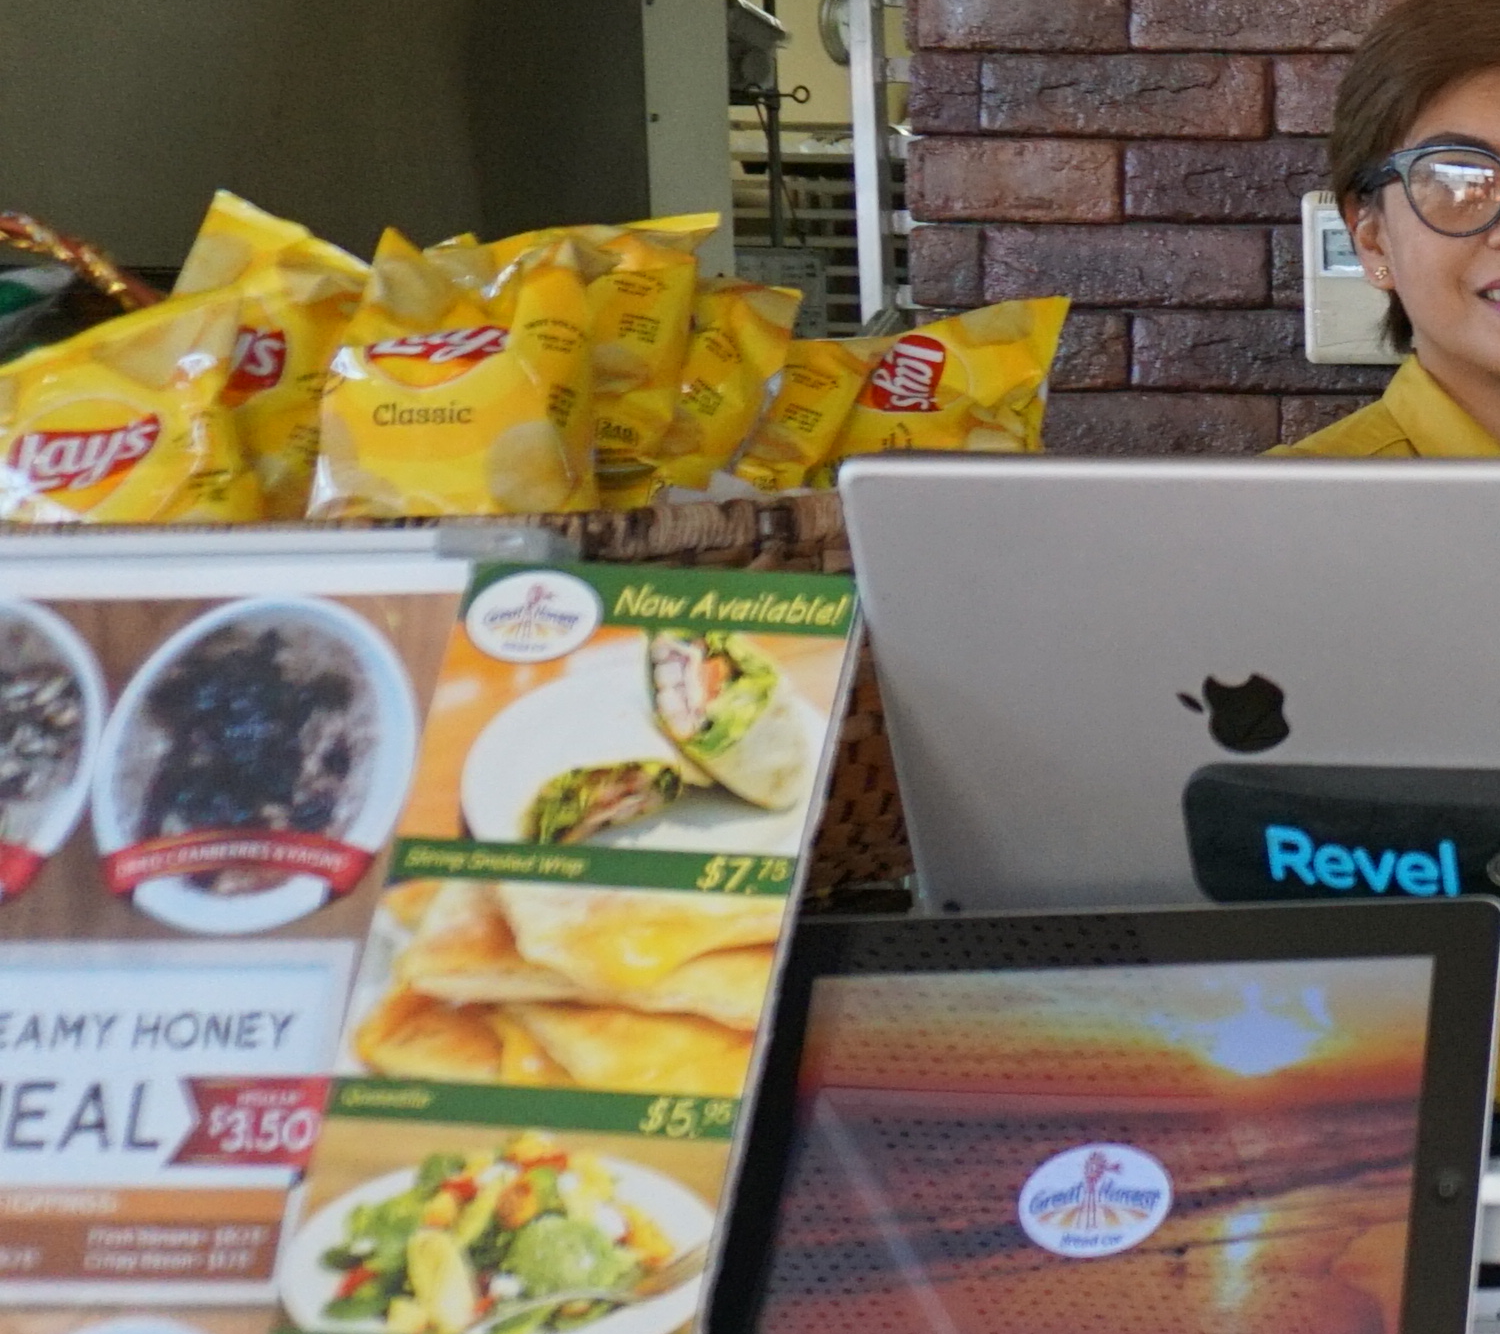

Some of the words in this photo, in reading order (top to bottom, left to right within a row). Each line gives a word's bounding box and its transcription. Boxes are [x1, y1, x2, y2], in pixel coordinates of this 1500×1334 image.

[372, 401, 473, 429] Classic
[613, 583, 682, 619] Now
[688, 590, 852, 627] Available!
[1264, 822, 1460, 897] Revel
[130, 1011, 296, 1051] HONEY
[204, 1102, 320, 1155] $3.50
